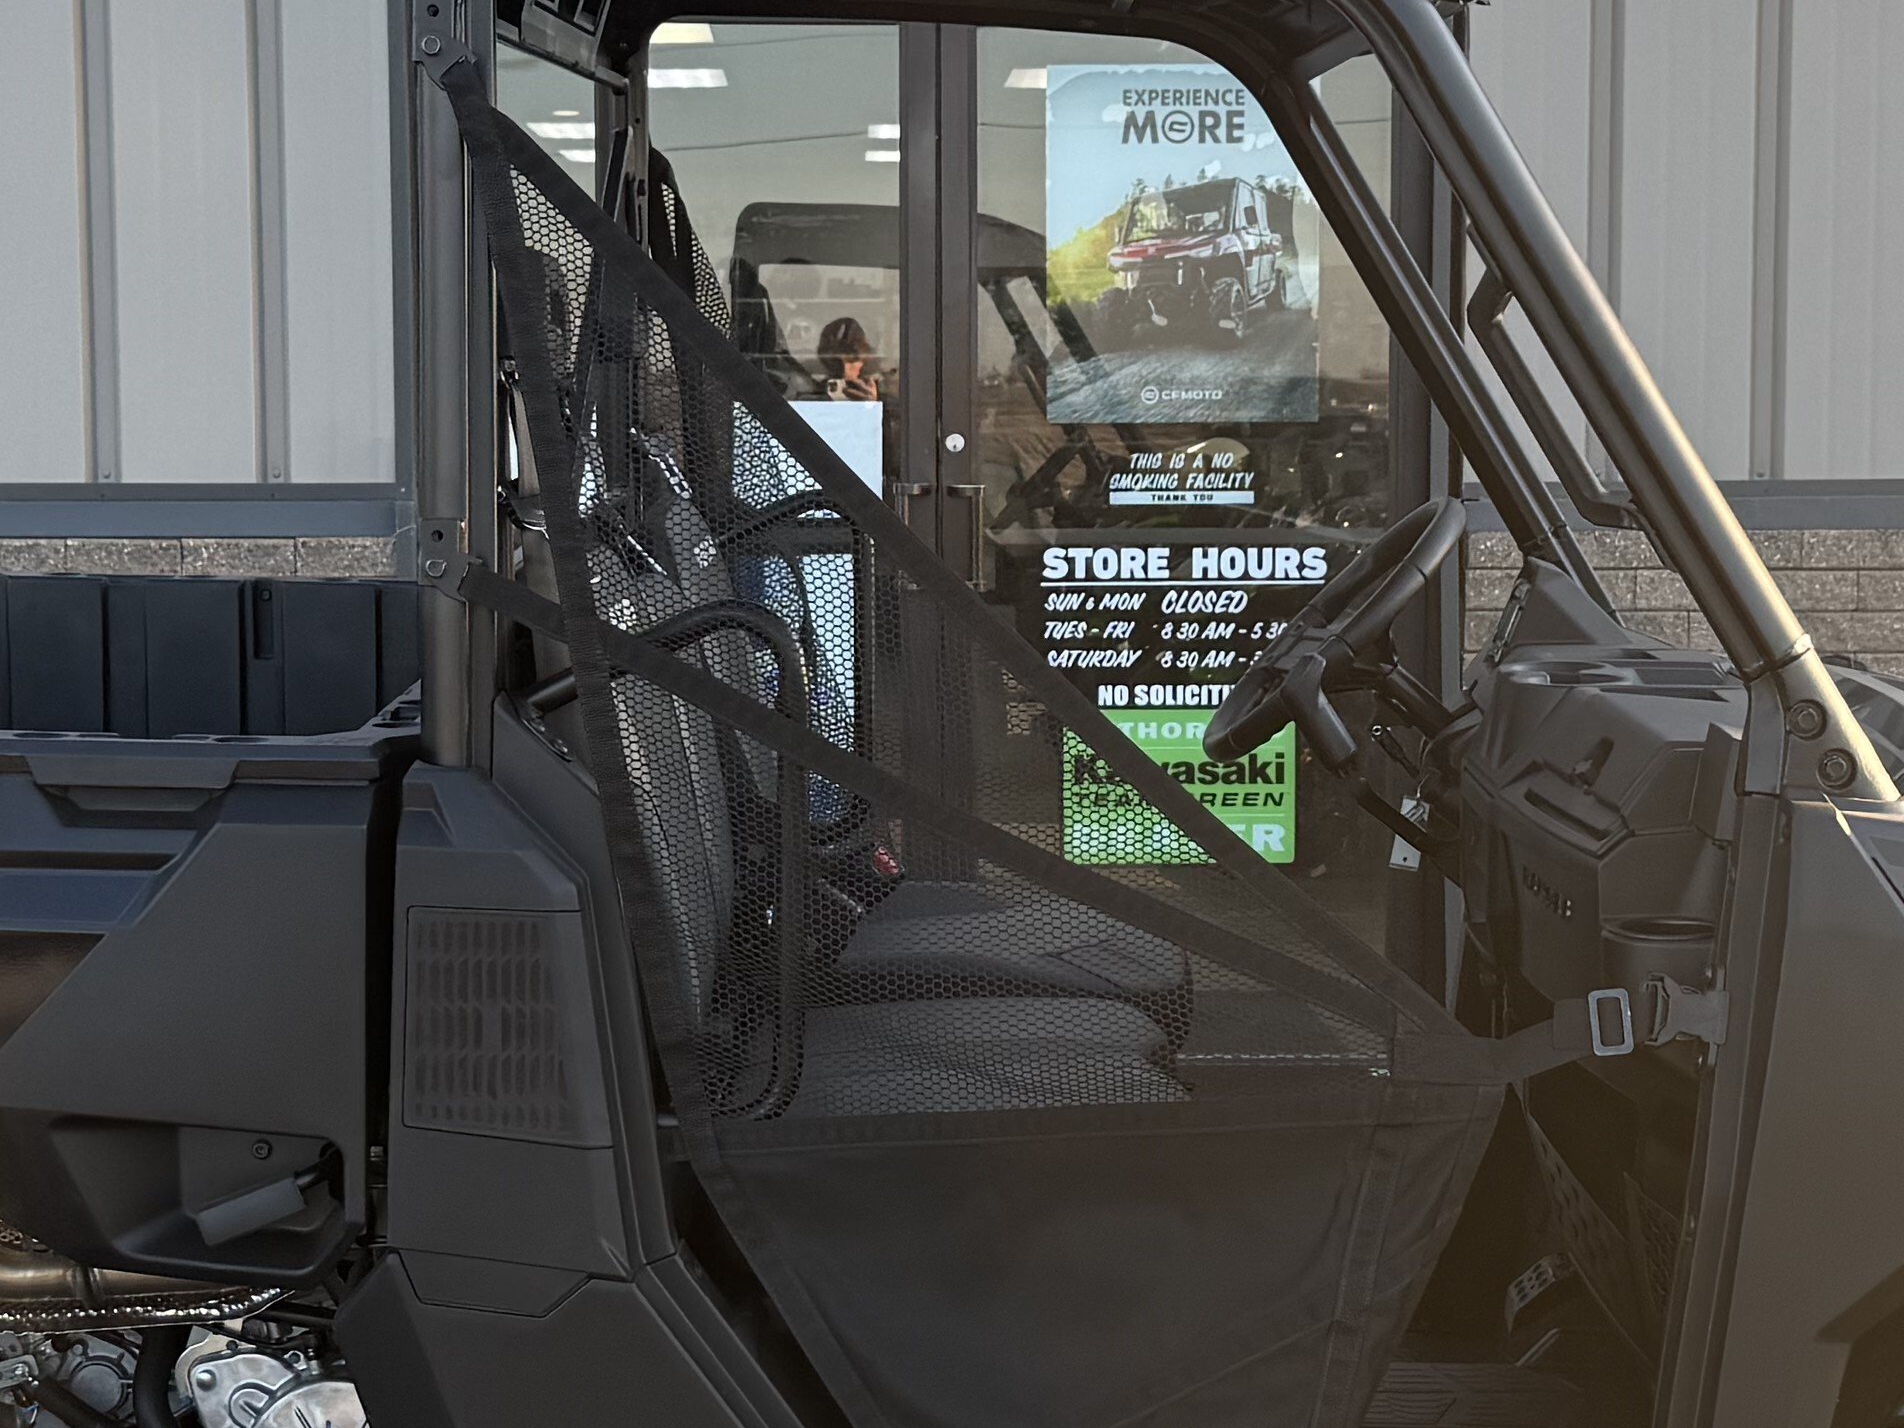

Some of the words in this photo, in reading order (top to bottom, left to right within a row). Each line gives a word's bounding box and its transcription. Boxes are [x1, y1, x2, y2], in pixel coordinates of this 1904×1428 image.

[1122, 88, 1245, 107] EXPERIENCE
[1161, 390, 1223, 400] CFMOTO
[1130, 452, 1163, 469] THIS
[1170, 452, 1186, 469] IS
[1192, 452, 1204, 469] A
[1211, 452, 1234, 469] NO
[1109, 472, 1179, 490] SMOKING
[1186, 471, 1254, 490] FACILITY
[1151, 493, 1187, 502] THANK
[1192, 493, 1214, 502] YOU
[1042, 547, 1170, 579] STORE
[1191, 547, 1328, 579] HOURS
[1044, 592, 1086, 611] SUN
[1098, 592, 1147, 611] MON
[1161, 589, 1249, 614] CLOSED
[1044, 621, 1087, 640] TUES
[1103, 621, 1135, 639] FRI
[1201, 620, 1236, 640] AM
[1047, 649, 1143, 668] SATURDAY
[1201, 649, 1236, 668] AM
[1098, 684, 1130, 706] NO
[1197, 791, 1284, 807] REEN
